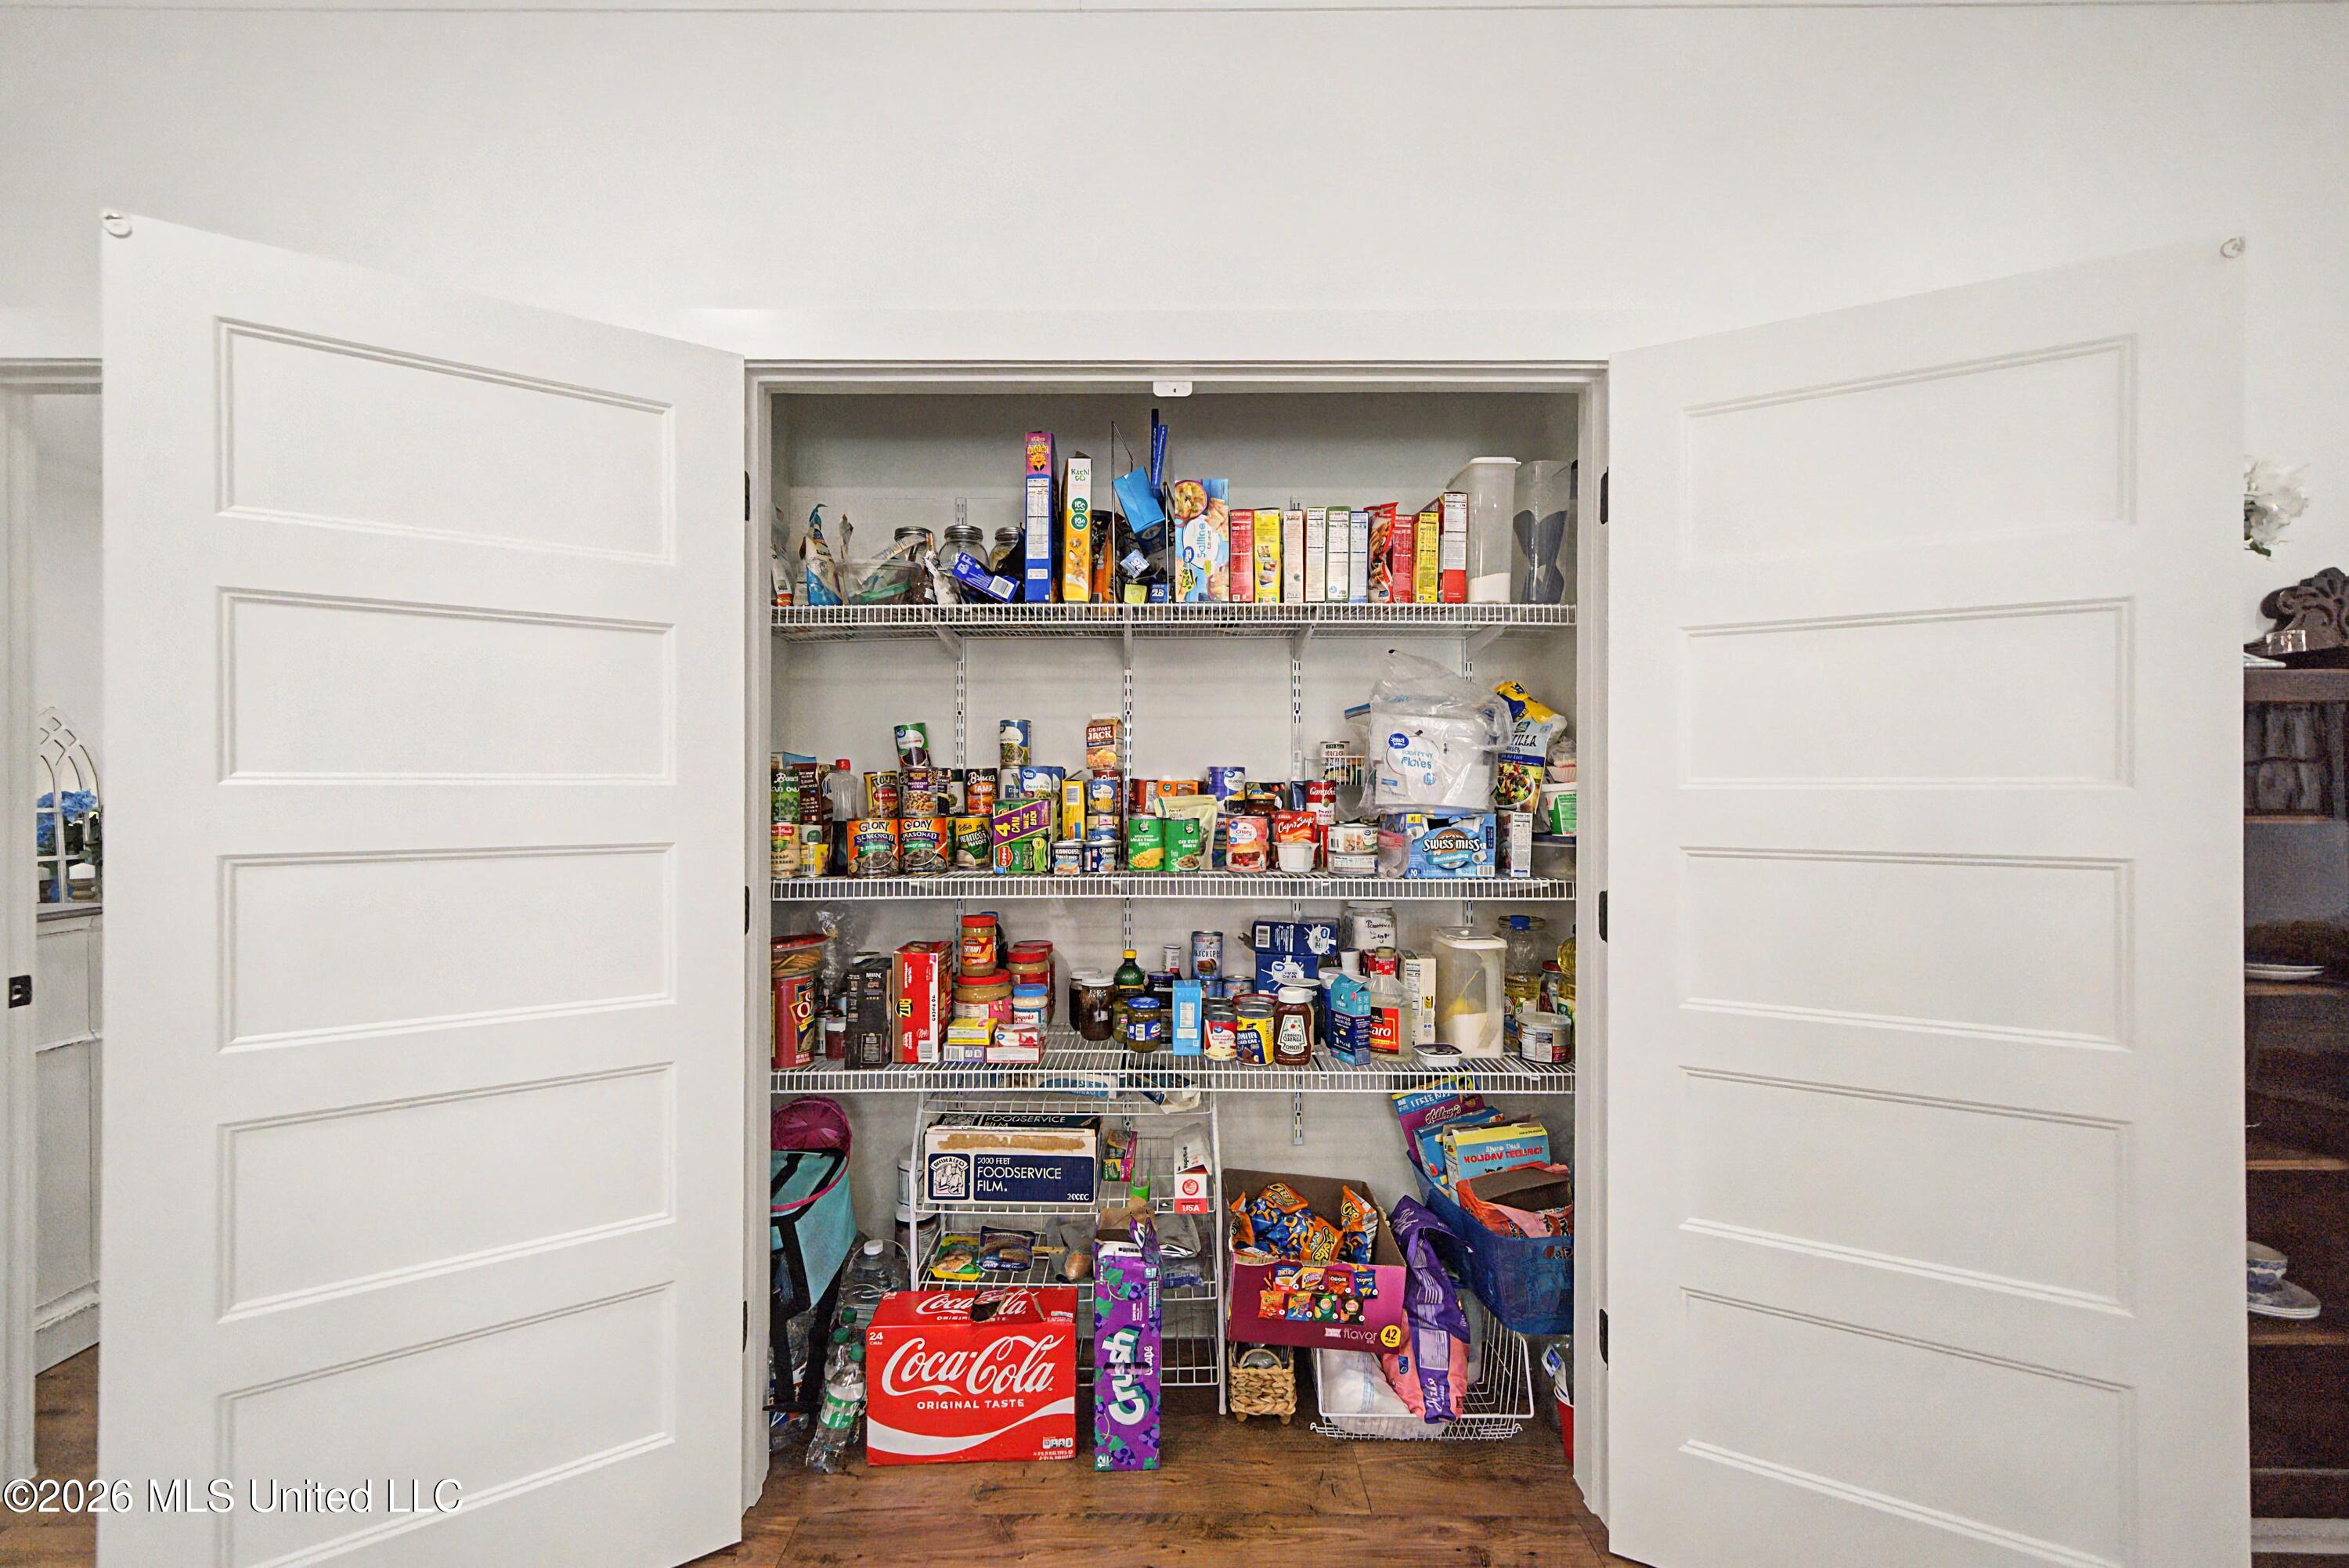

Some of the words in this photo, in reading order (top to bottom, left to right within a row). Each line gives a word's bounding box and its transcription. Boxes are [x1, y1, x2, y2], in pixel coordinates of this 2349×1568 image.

[995, 823, 1011, 837] 4
[1423, 838, 1454, 851] SWISS
[1454, 838, 1481, 851] MISS
[1370, 1026, 1391, 1037] aro
[986, 1115, 1066, 1124] FOODSERVICE
[977, 1166, 1062, 1181] FOODSERVICE
[869, 1332, 884, 1341] 24
[1344, 1328, 1378, 1341] flavor
[1384, 1328, 1398, 1340] 42
[882, 1334, 1066, 1397] Coca-Cola
[917, 1400, 980, 1410] ORIGINAL
[985, 1398, 1025, 1408] TASTE
